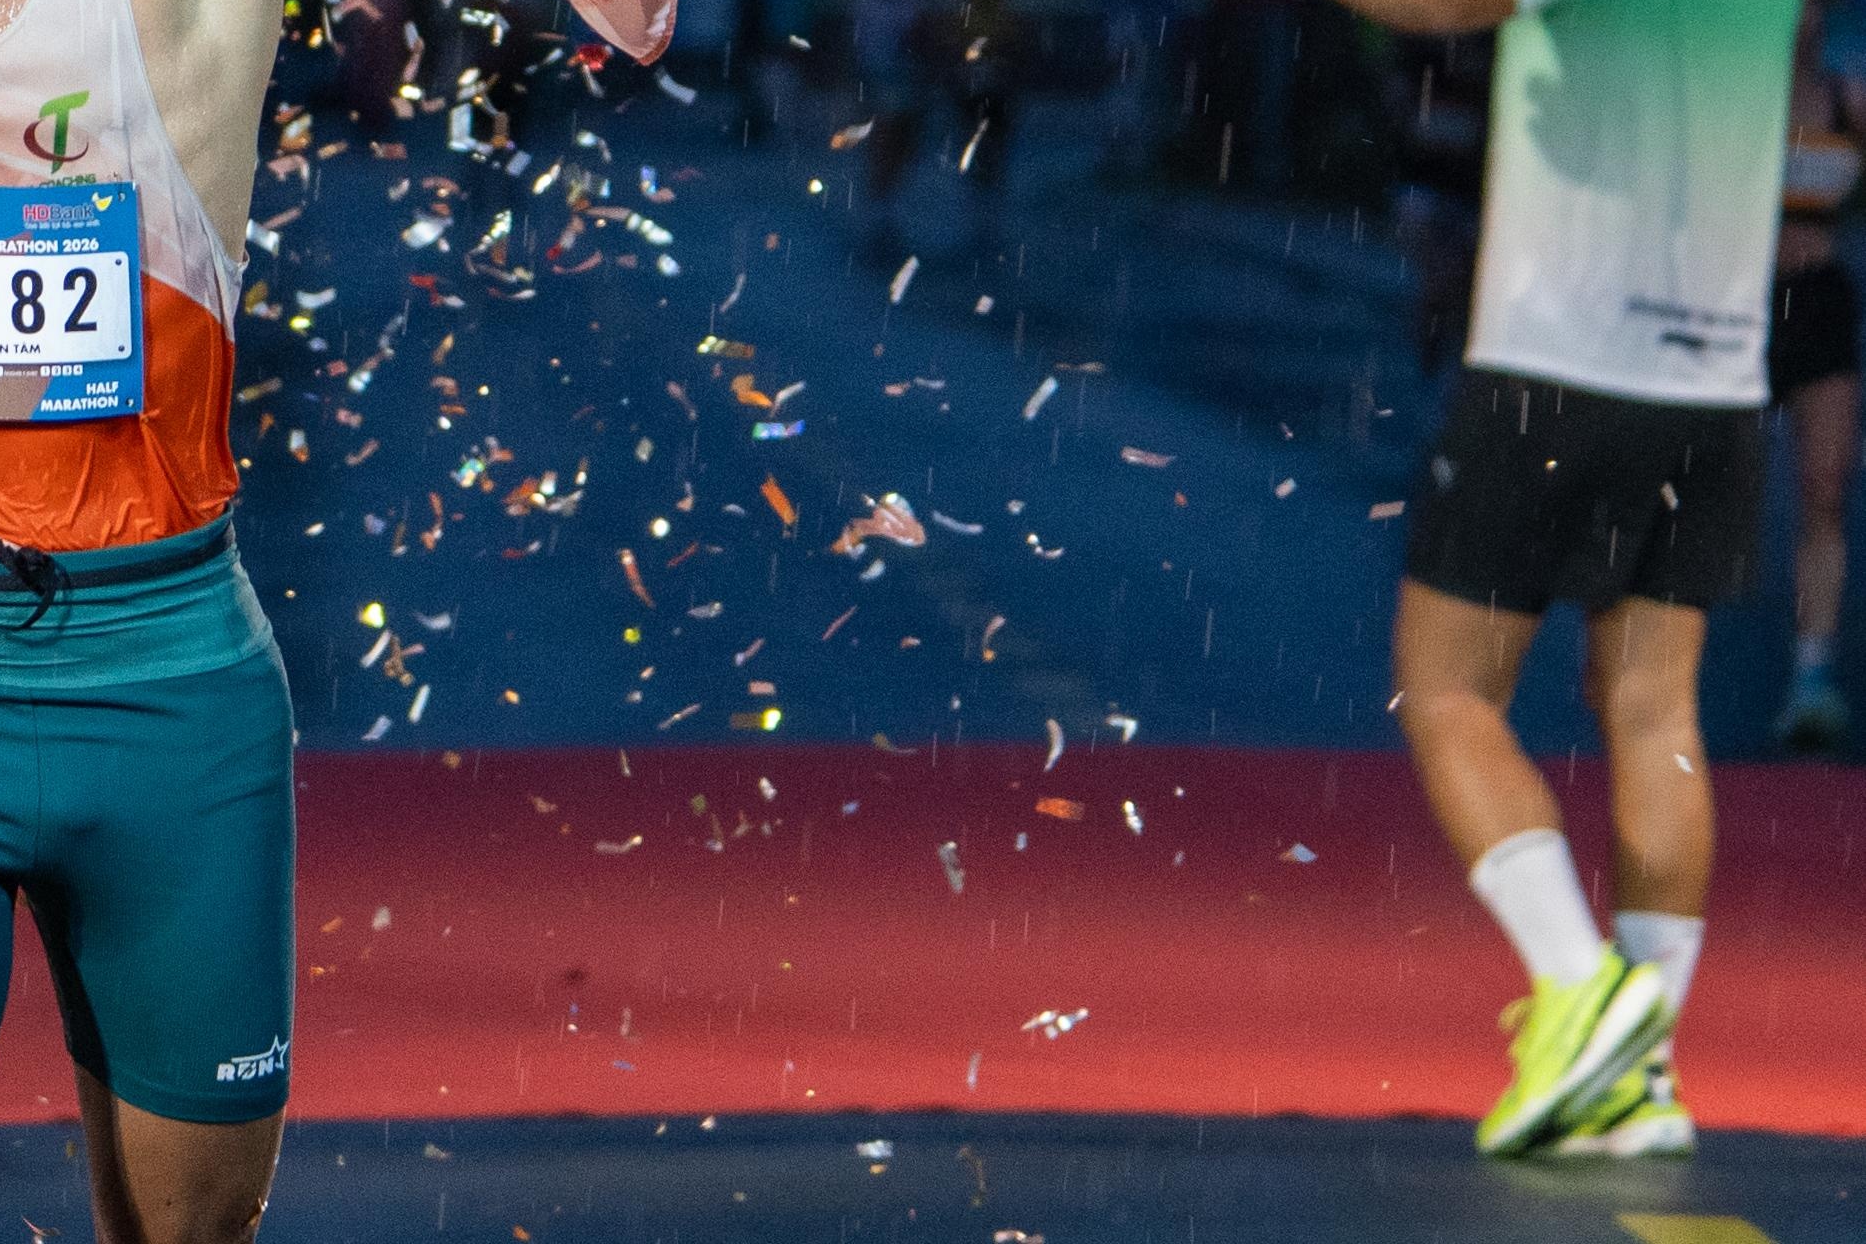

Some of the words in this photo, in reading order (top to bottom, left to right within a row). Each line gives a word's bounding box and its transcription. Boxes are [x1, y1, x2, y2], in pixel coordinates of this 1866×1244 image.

[23, 203, 95, 222] HDBank
[62, 237, 99, 252] 2026
[86, 382, 119, 395] HALF
[40, 396, 119, 412] MARATHON
